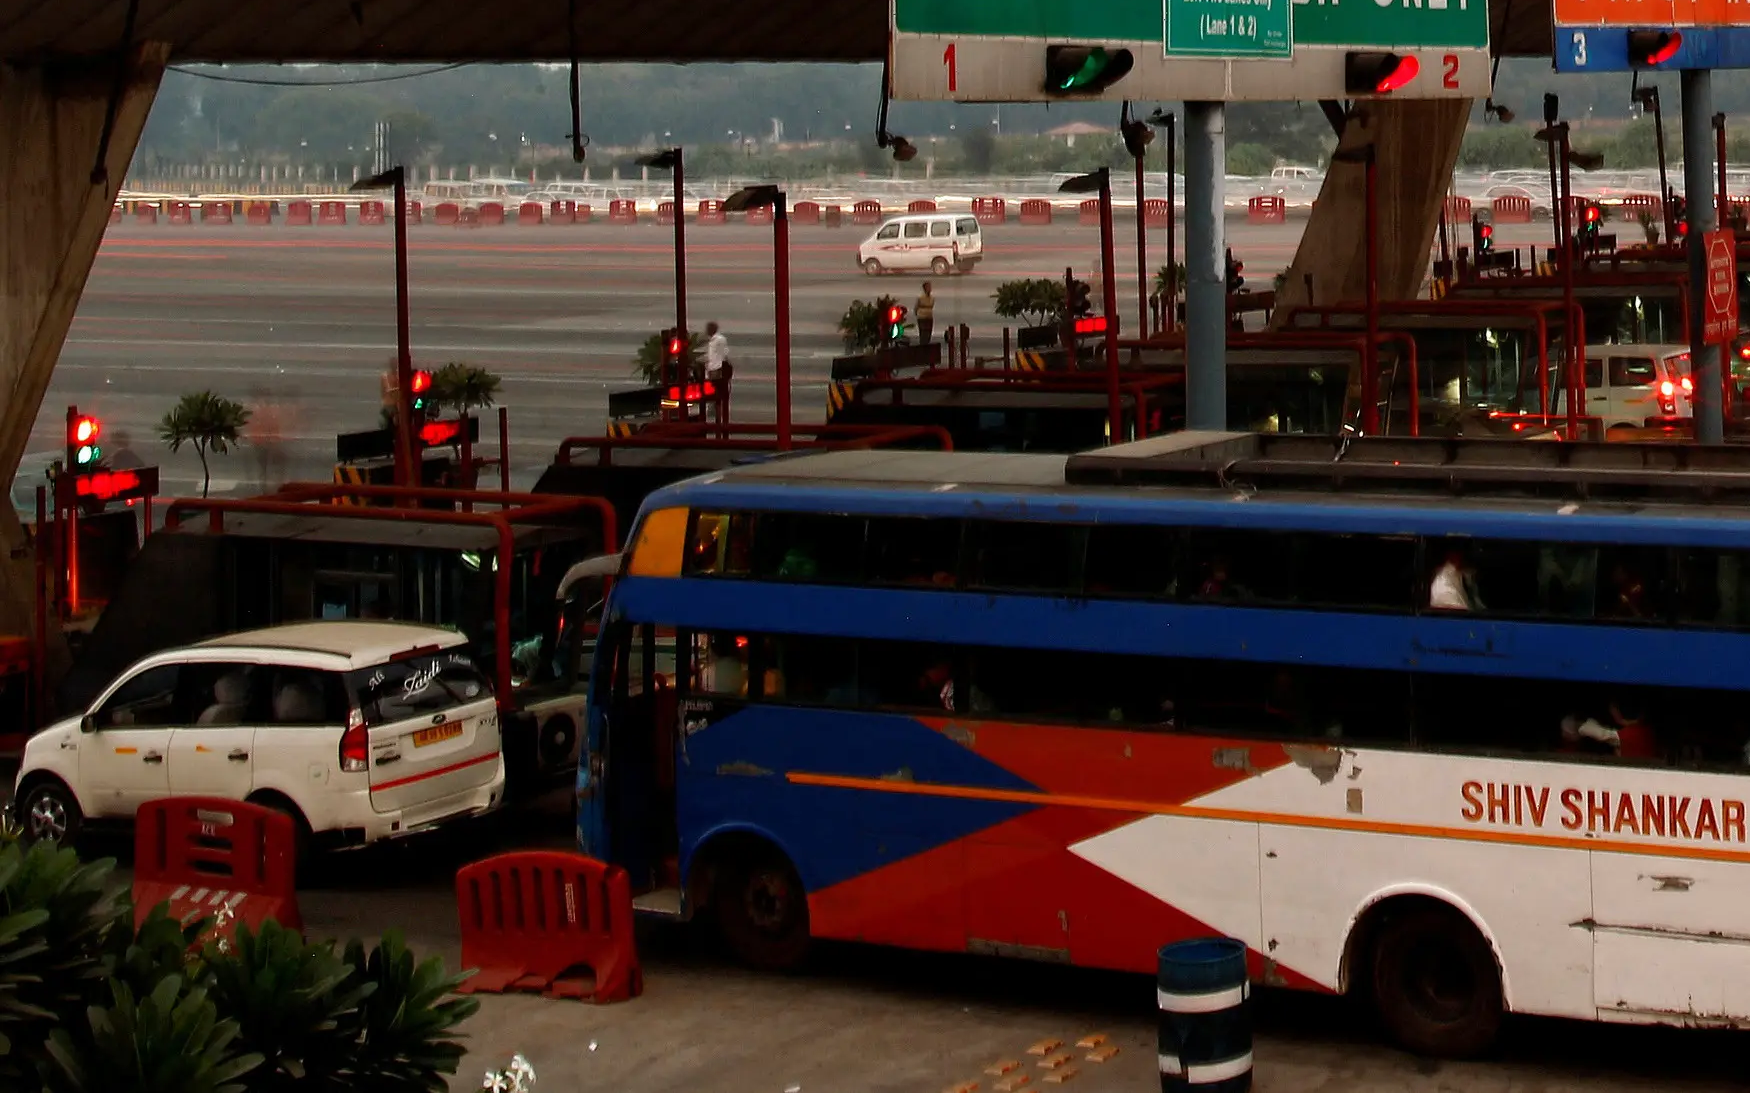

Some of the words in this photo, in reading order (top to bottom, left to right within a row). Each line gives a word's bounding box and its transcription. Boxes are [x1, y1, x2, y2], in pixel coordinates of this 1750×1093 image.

[1230, 14, 1235, 35] 1
[1238, 15, 1245, 36] &
[1573, 32, 1587, 66] 3
[943, 43, 957, 91] 1
[1443, 54, 1460, 89] 2
[1461, 780, 1551, 828] SHIV
[1560, 788, 1747, 843] SHANKAR
